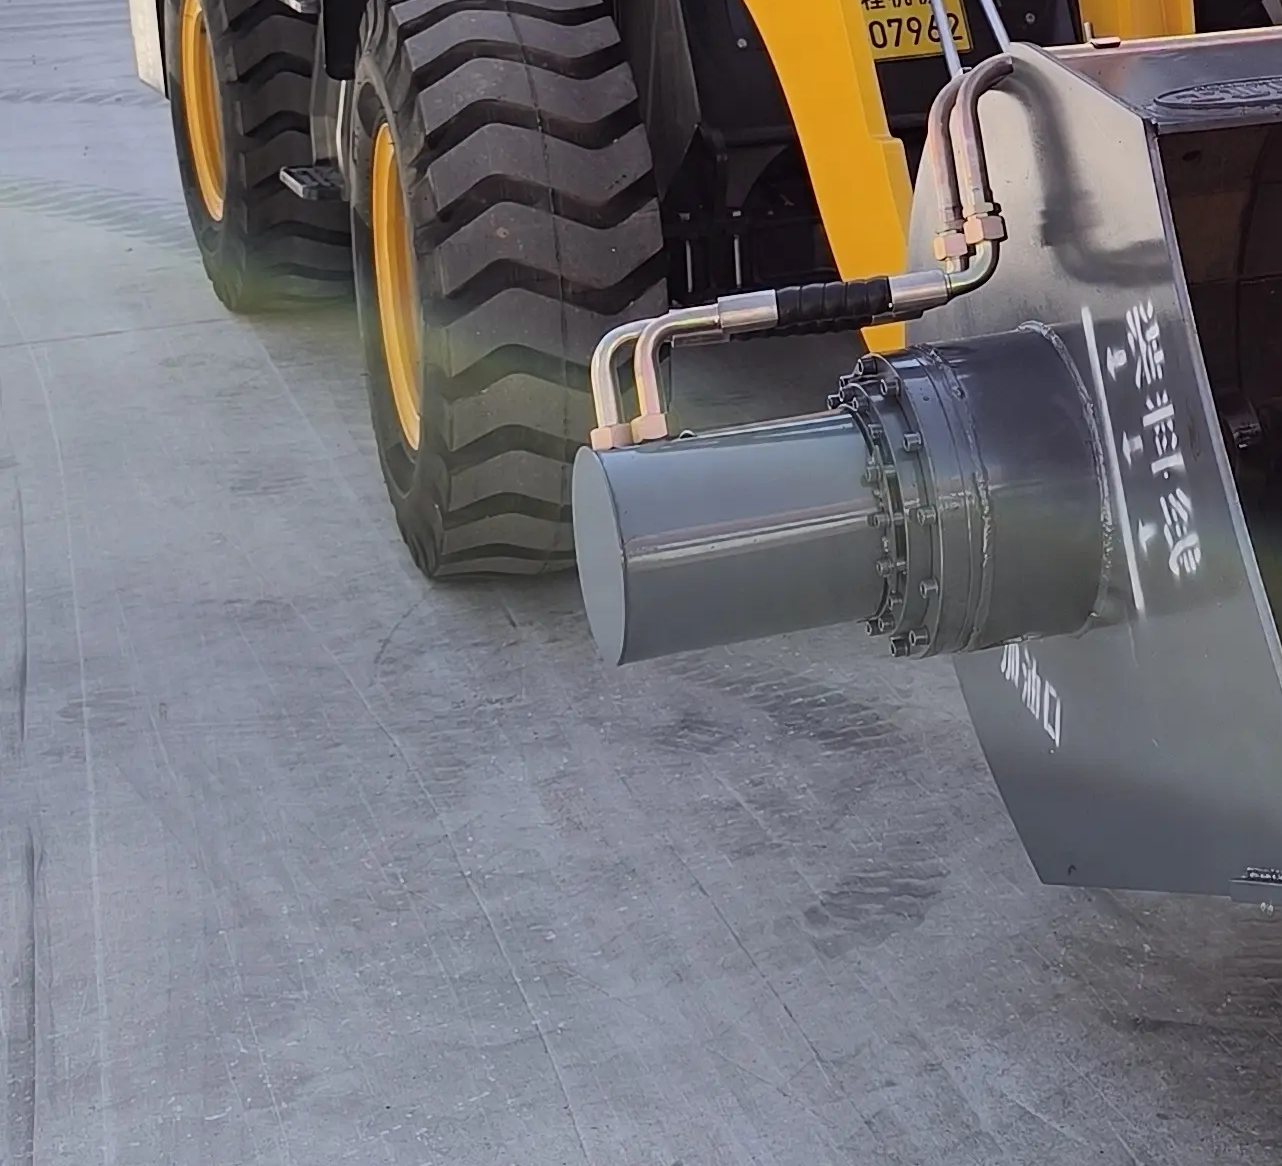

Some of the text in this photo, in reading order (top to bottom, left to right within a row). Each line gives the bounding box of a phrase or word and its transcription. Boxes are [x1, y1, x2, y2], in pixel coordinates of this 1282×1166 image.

[868, 13, 963, 49] 07962
[1126, 299, 1202, 576] 装料线
